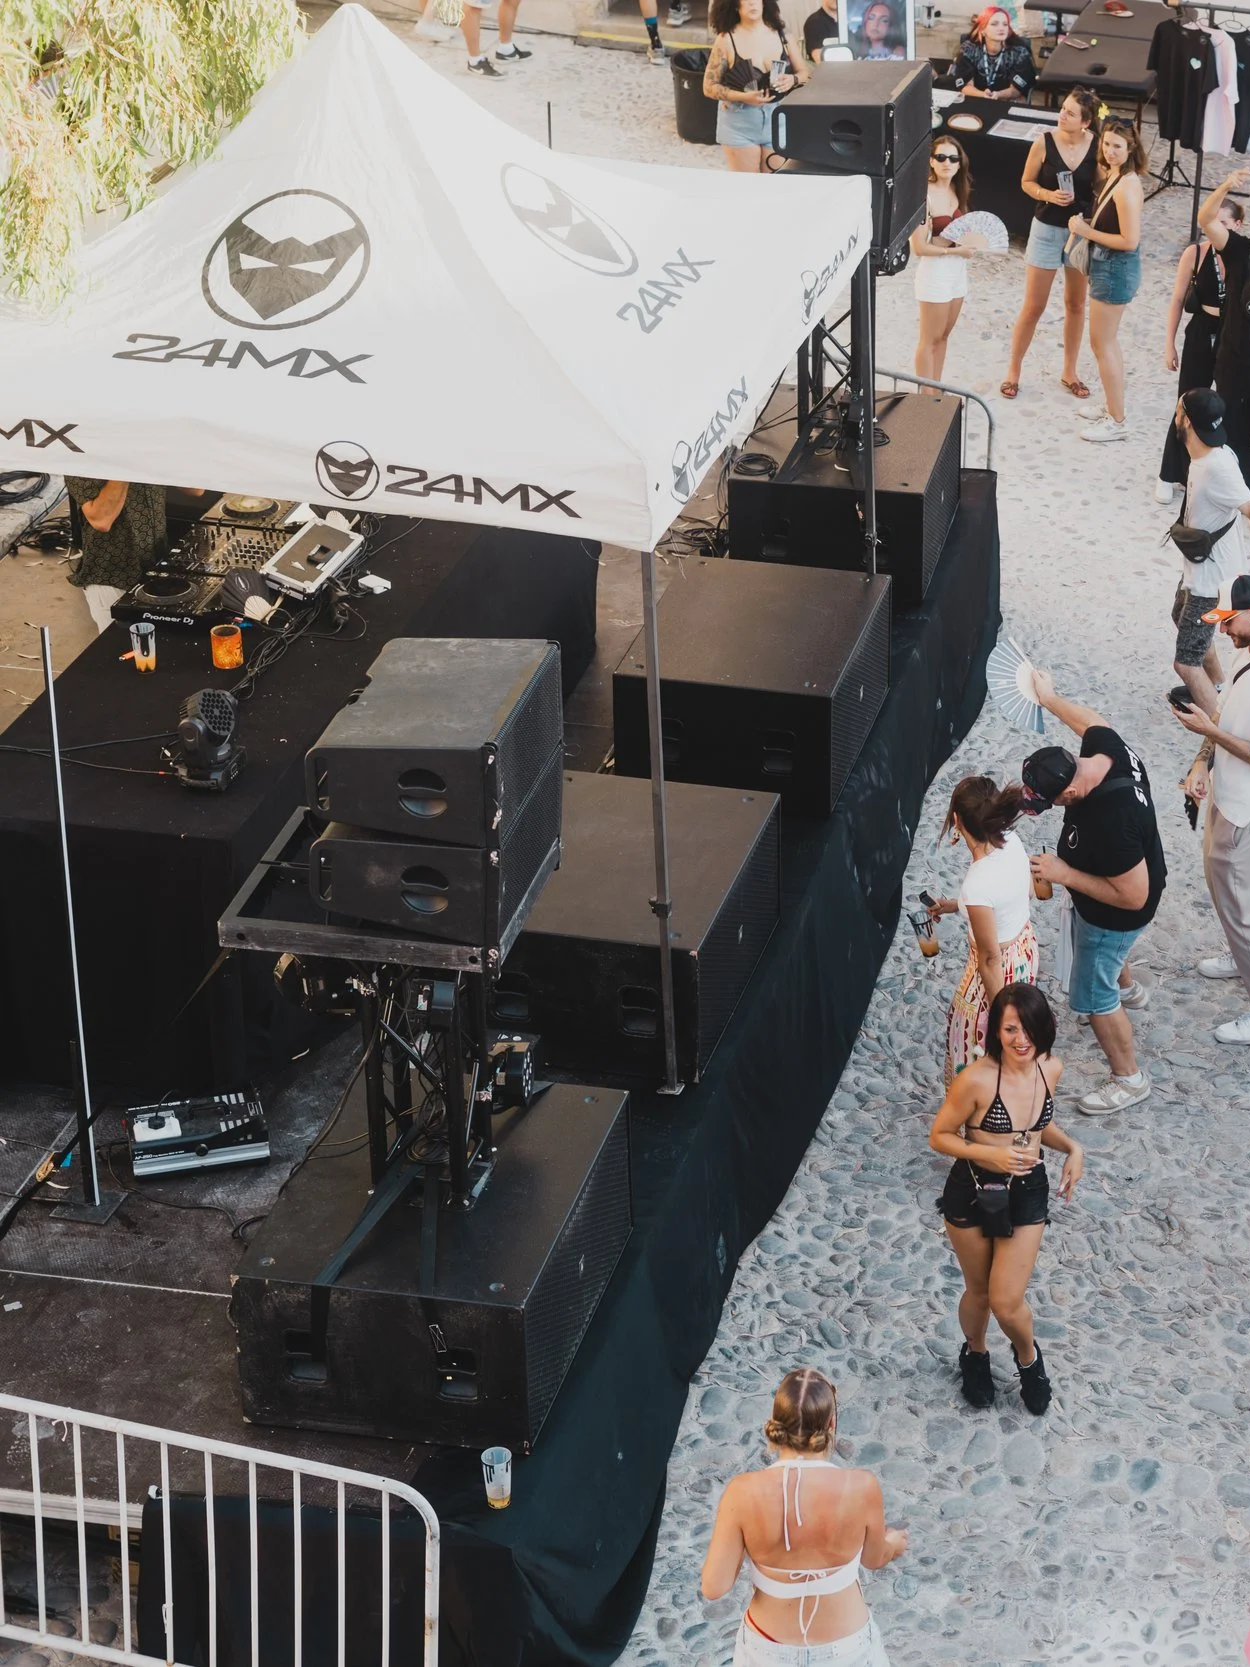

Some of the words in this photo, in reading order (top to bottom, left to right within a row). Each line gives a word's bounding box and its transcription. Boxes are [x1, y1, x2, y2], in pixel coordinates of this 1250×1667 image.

[616, 247, 716, 334] 24MX
[112, 333, 376, 385] 24MX
[693, 375, 749, 472] 24MX
[384, 464, 583, 519] 24MX
[143, 612, 181, 623] Pioneer
